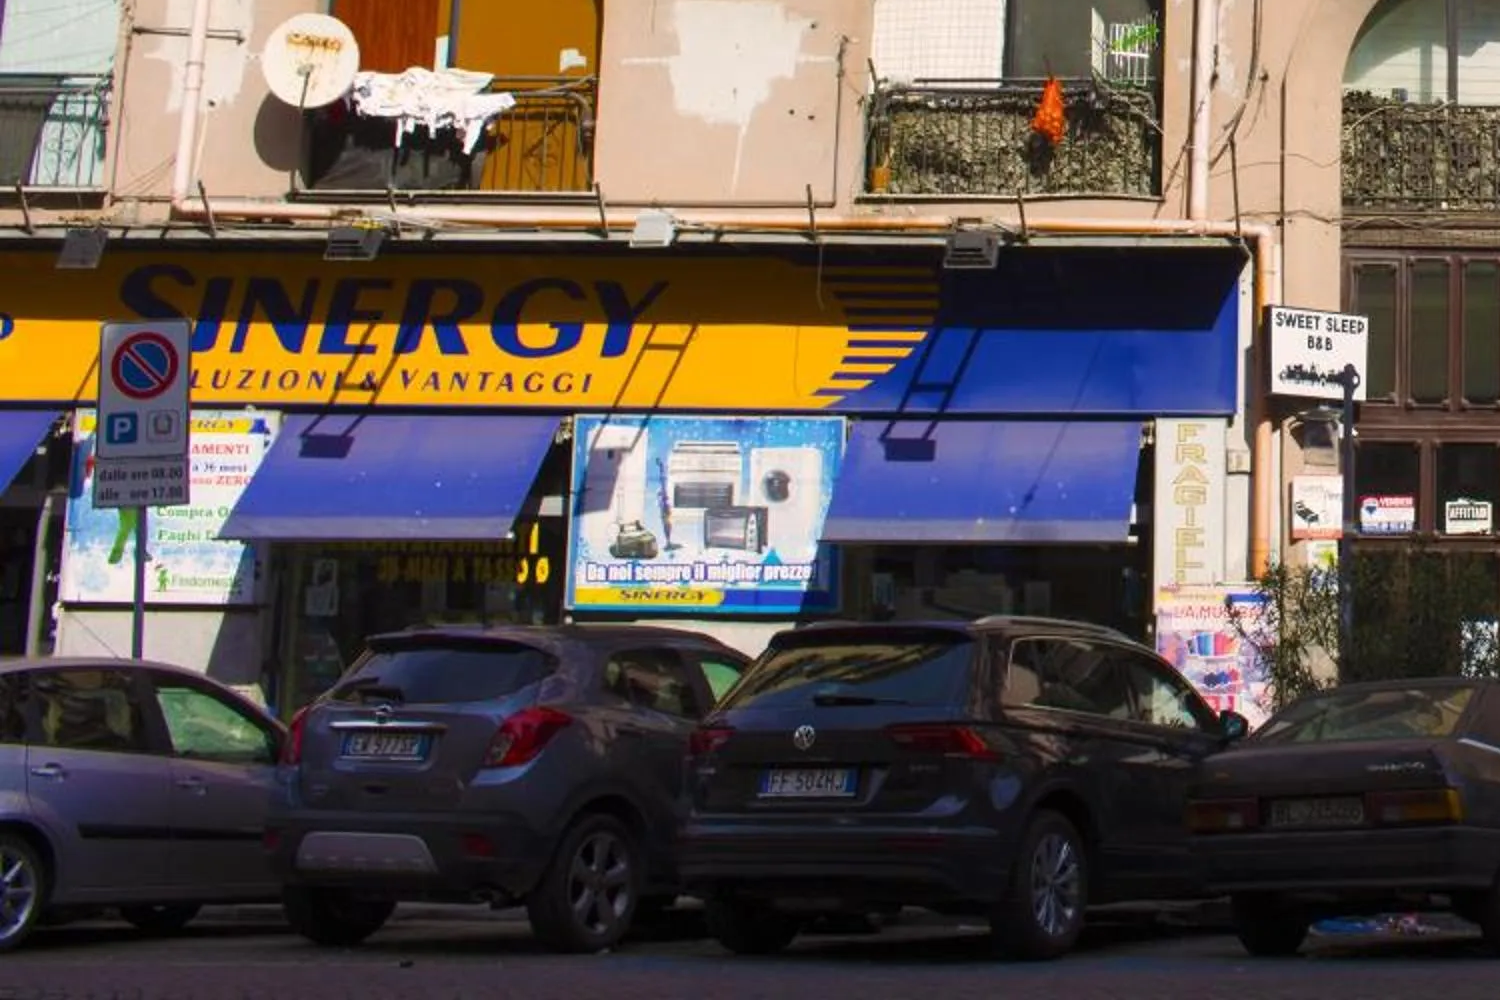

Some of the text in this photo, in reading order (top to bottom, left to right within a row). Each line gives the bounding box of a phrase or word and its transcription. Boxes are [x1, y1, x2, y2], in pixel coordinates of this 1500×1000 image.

[119, 263, 670, 358] SINERGY
[1275, 311, 1365, 334] SWEET SLEEP
[1307, 335, 1333, 351] B&B
[191, 369, 346, 390] LUZIONI
[400, 368, 593, 393] VANTAGGI
[113, 417, 131, 441] P
[191, 443, 250, 454] AMENTI
[586, 562, 607, 582] Da
[607, 562, 632, 582] noi
[634, 564, 692, 584] sempre
[693, 562, 705, 582] il
[706, 562, 762, 584] miglior
[618, 589, 706, 601] SINERGY
